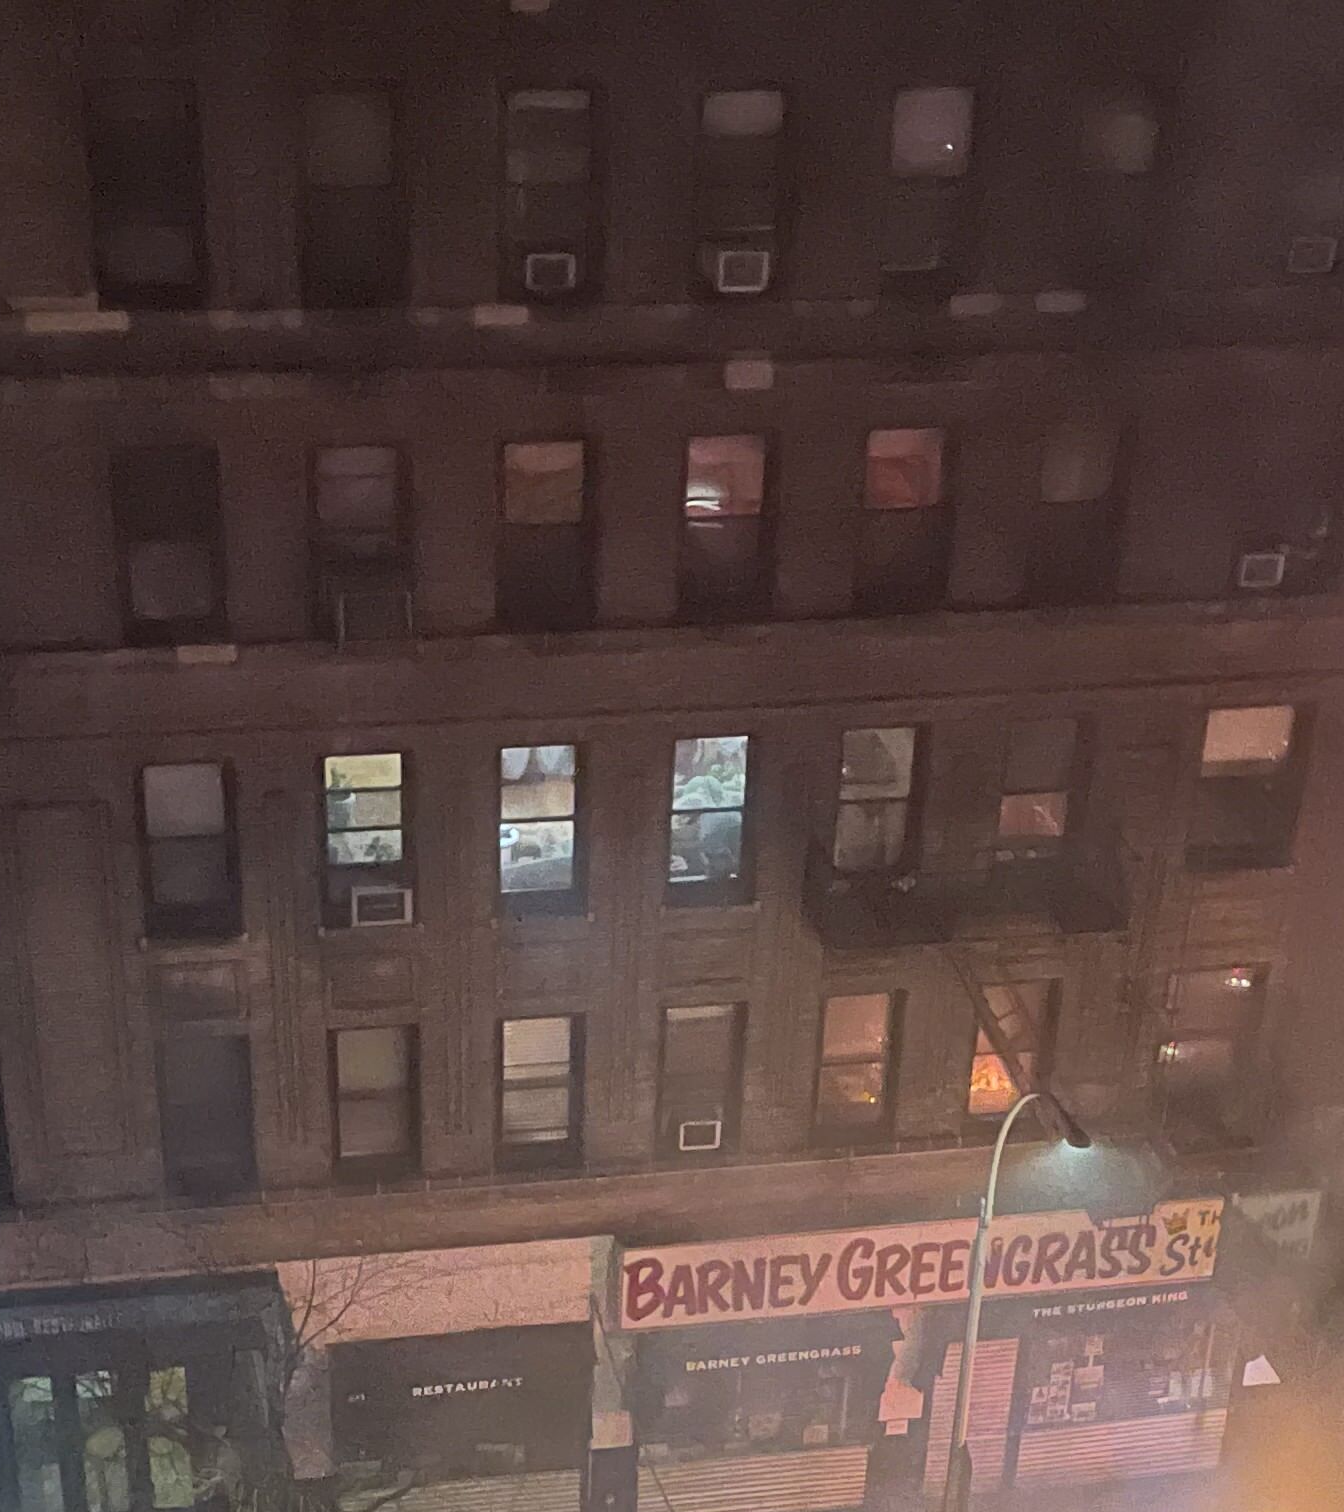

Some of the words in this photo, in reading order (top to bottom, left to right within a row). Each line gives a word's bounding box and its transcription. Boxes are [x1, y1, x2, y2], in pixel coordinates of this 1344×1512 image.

[623, 1253, 833, 1321] BARNEY
[836, 1225, 1156, 1301] GREENGRASS
[1033, 1306, 1063, 1319] THE
[1067, 1296, 1147, 1314] STURGEON
[1151, 1290, 1189, 1305] KING
[685, 1356, 751, 1372] BARNEY
[755, 1345, 862, 1365] GREENGRASS
